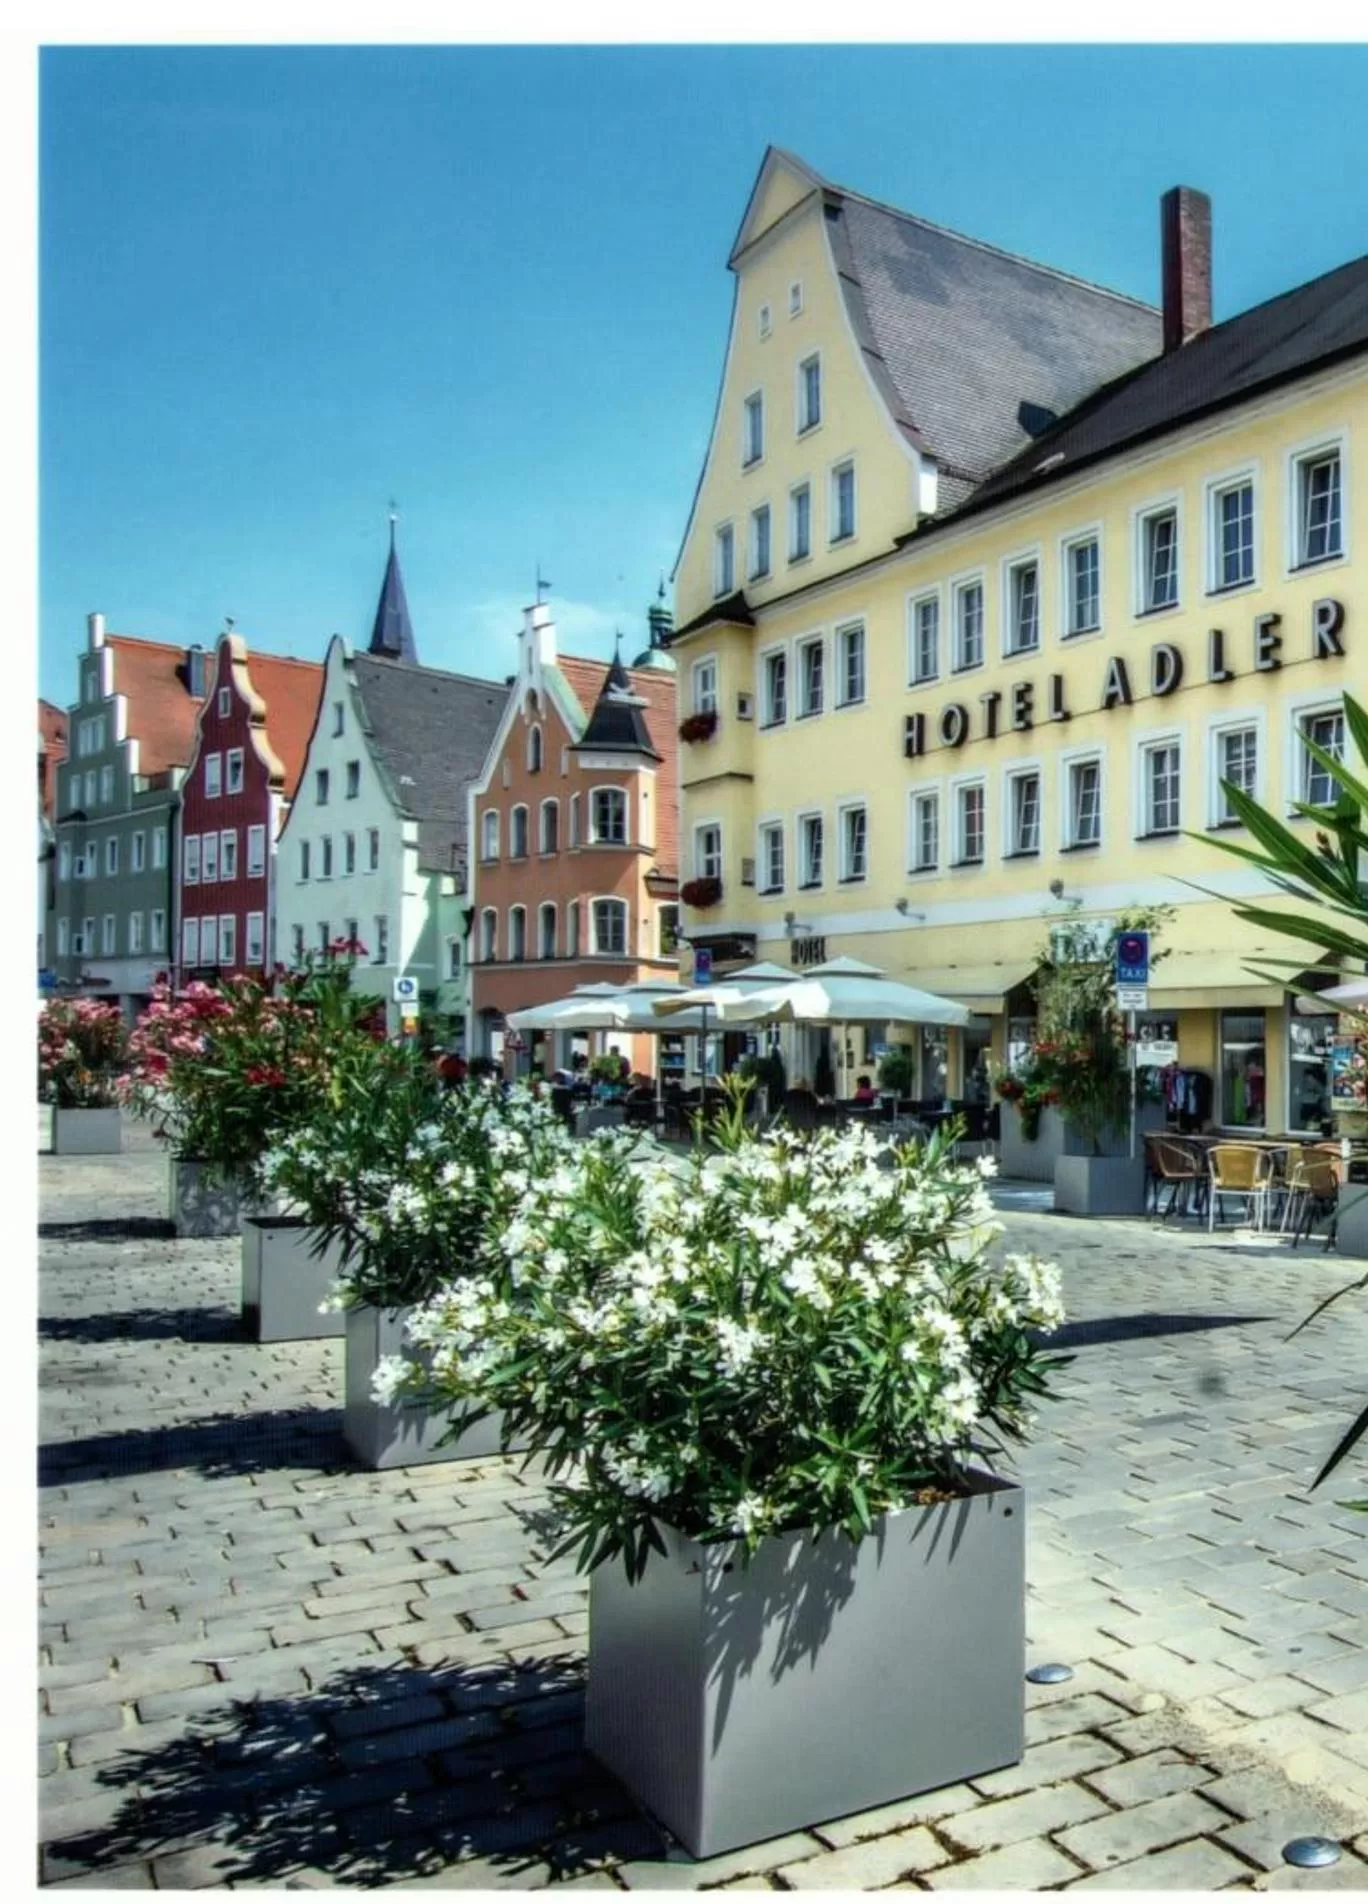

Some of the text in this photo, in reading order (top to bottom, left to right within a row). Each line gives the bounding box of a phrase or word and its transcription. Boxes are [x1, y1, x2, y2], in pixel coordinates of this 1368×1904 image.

[904, 598, 1346, 758] HOTEL ADLER
[1119, 967, 1146, 979] TAXI
